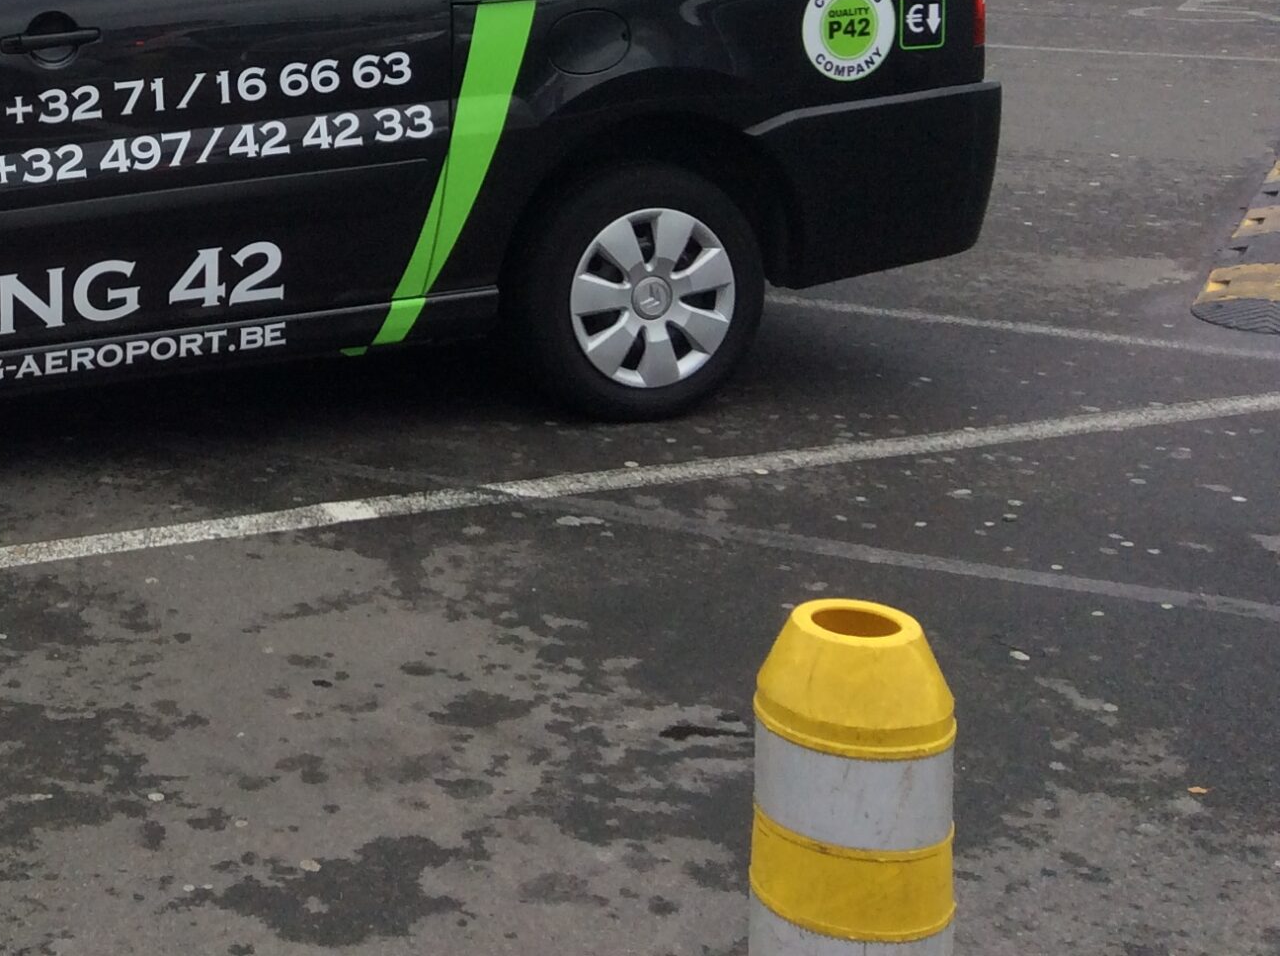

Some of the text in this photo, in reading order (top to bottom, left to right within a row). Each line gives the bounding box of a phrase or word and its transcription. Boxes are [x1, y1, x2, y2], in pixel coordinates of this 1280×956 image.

[828, 7, 871, 19] QUALITY
[828, 18, 871, 40] P42
[815, 46, 883, 77] COMPANY
[5, 85, 103, 125] +32
[279, 59, 340, 97] 66
[352, 51, 413, 89] 63
[302, 112, 364, 150] 42
[374, 104, 435, 142] 33
[169, 241, 285, 307] 42
